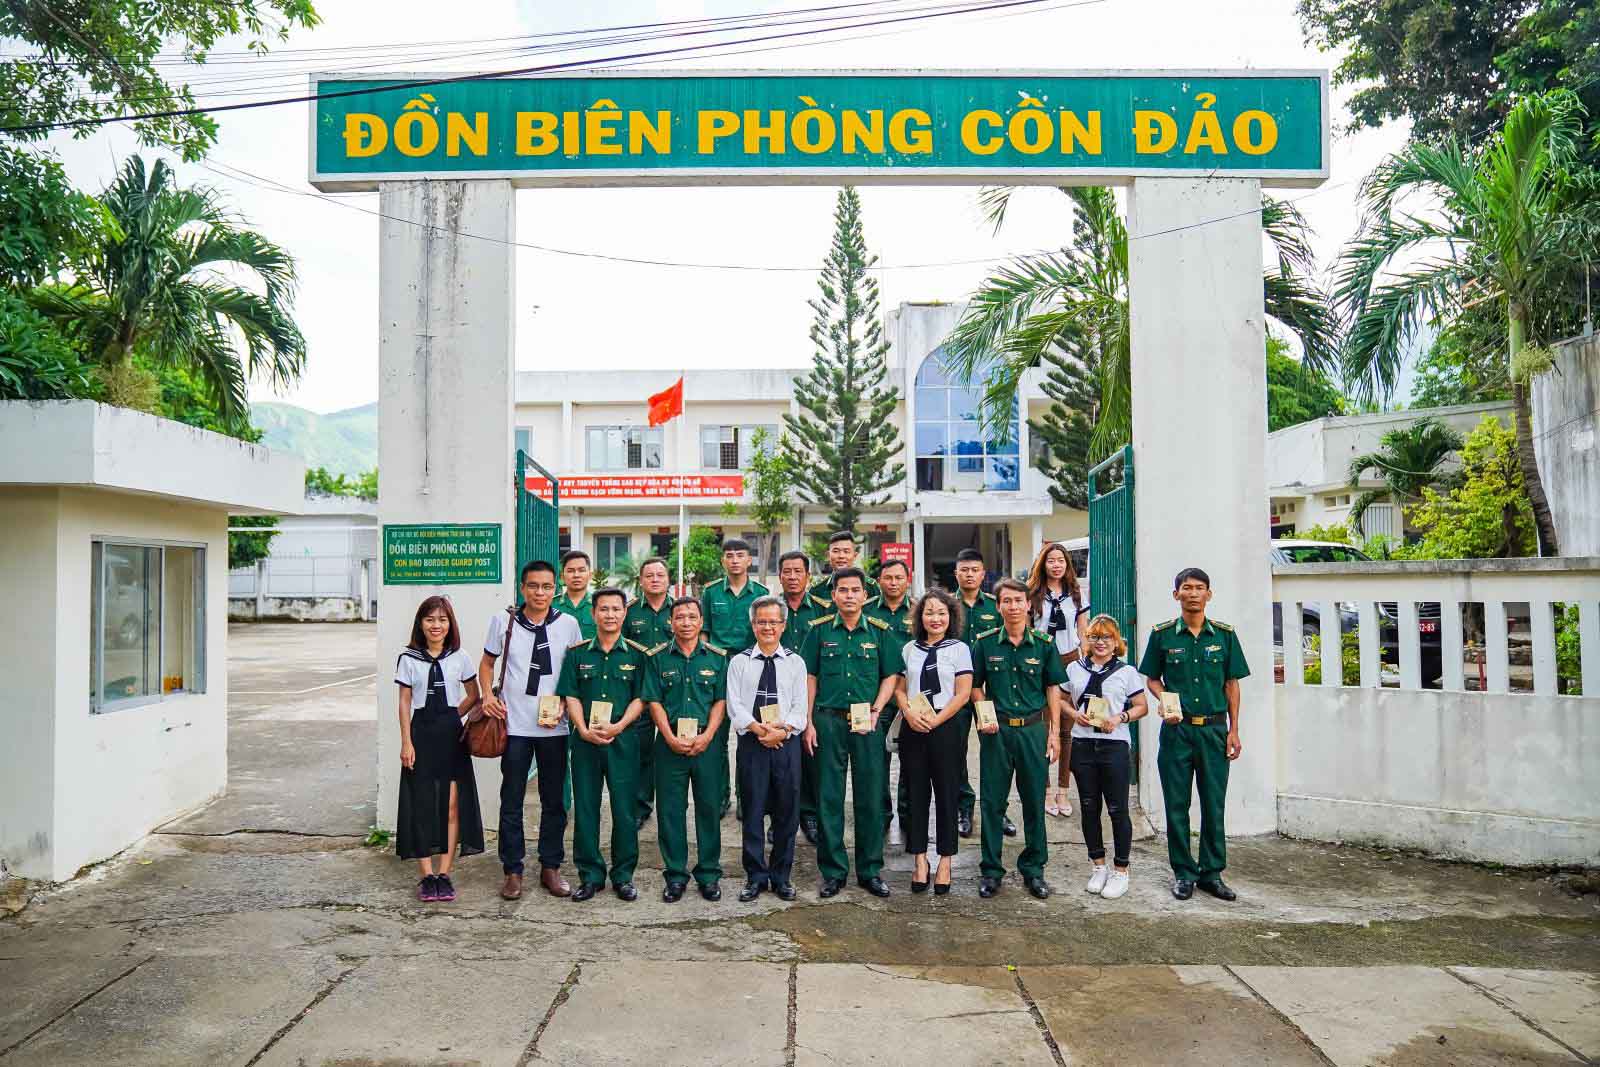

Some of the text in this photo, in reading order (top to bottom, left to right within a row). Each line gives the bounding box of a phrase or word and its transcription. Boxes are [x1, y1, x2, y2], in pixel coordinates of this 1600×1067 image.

[343, 92, 1279, 157] ĐỒN BIÊN PHÒNG CÔN ĐẢO
[474, 558, 491, 567] POST
